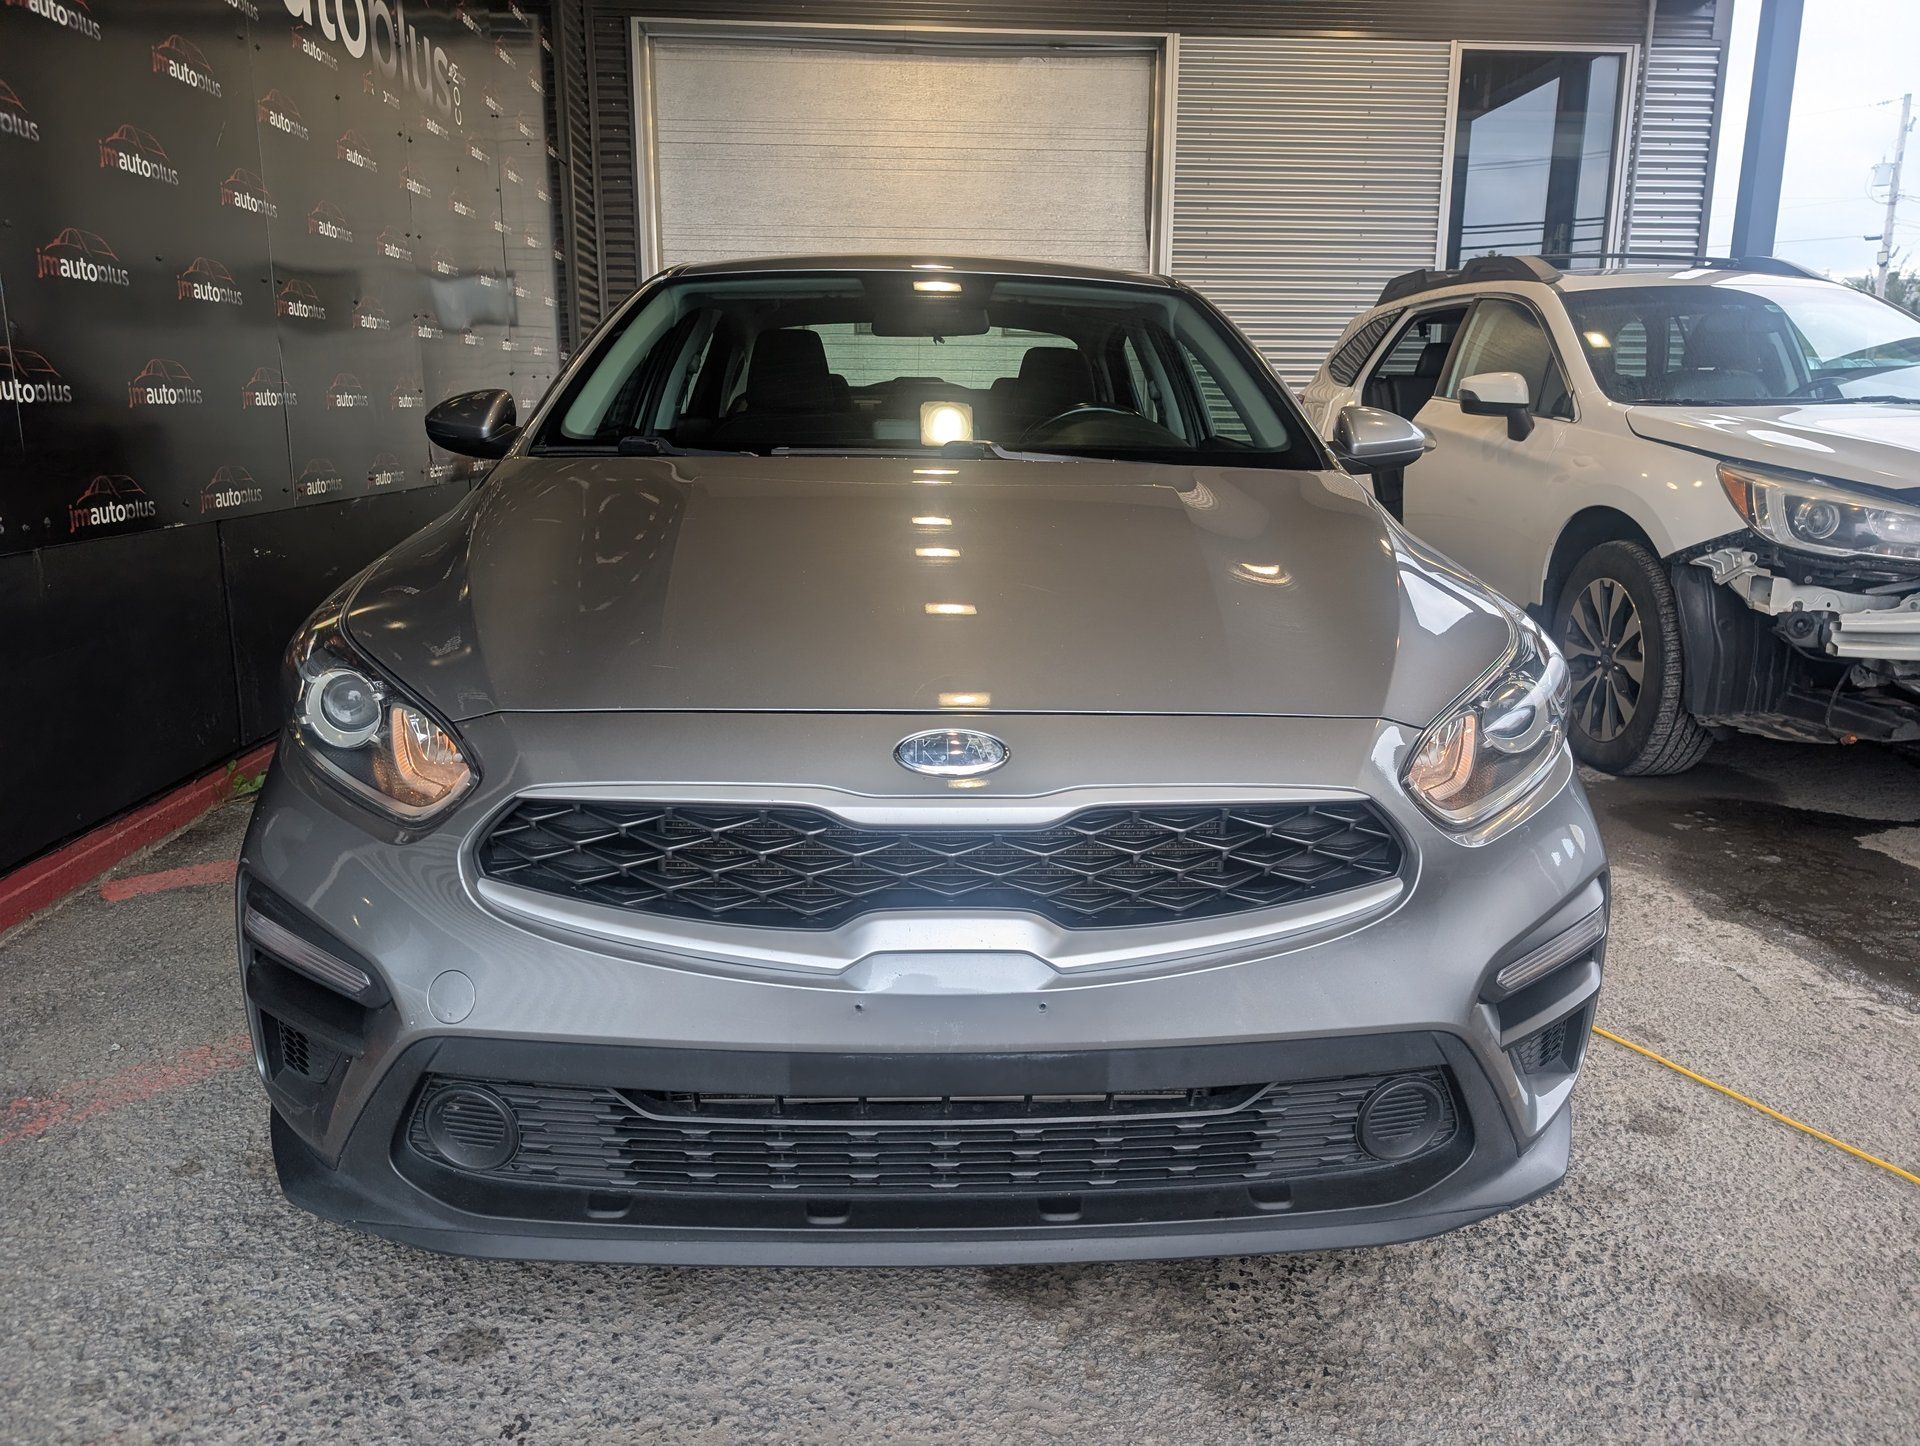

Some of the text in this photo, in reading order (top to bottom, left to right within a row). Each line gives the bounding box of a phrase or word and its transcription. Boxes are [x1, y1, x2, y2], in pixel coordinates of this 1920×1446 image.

[151, 45, 222, 98] jmautoplus
[99, 139, 179, 185] jmautoplus
[37, 248, 130, 286] jmautoplus
[177, 275, 243, 306] jmautoplus
[275, 293, 326, 321] jmautoplus
[0, 379, 72, 403] utoplus
[127, 381, 203, 409] jmautoplus
[242, 386, 298, 410] jmautoplus
[200, 487, 262, 514] jmautoplus
[68, 499, 156, 534] jmautoplus
[914, 736, 991, 763] KIA
